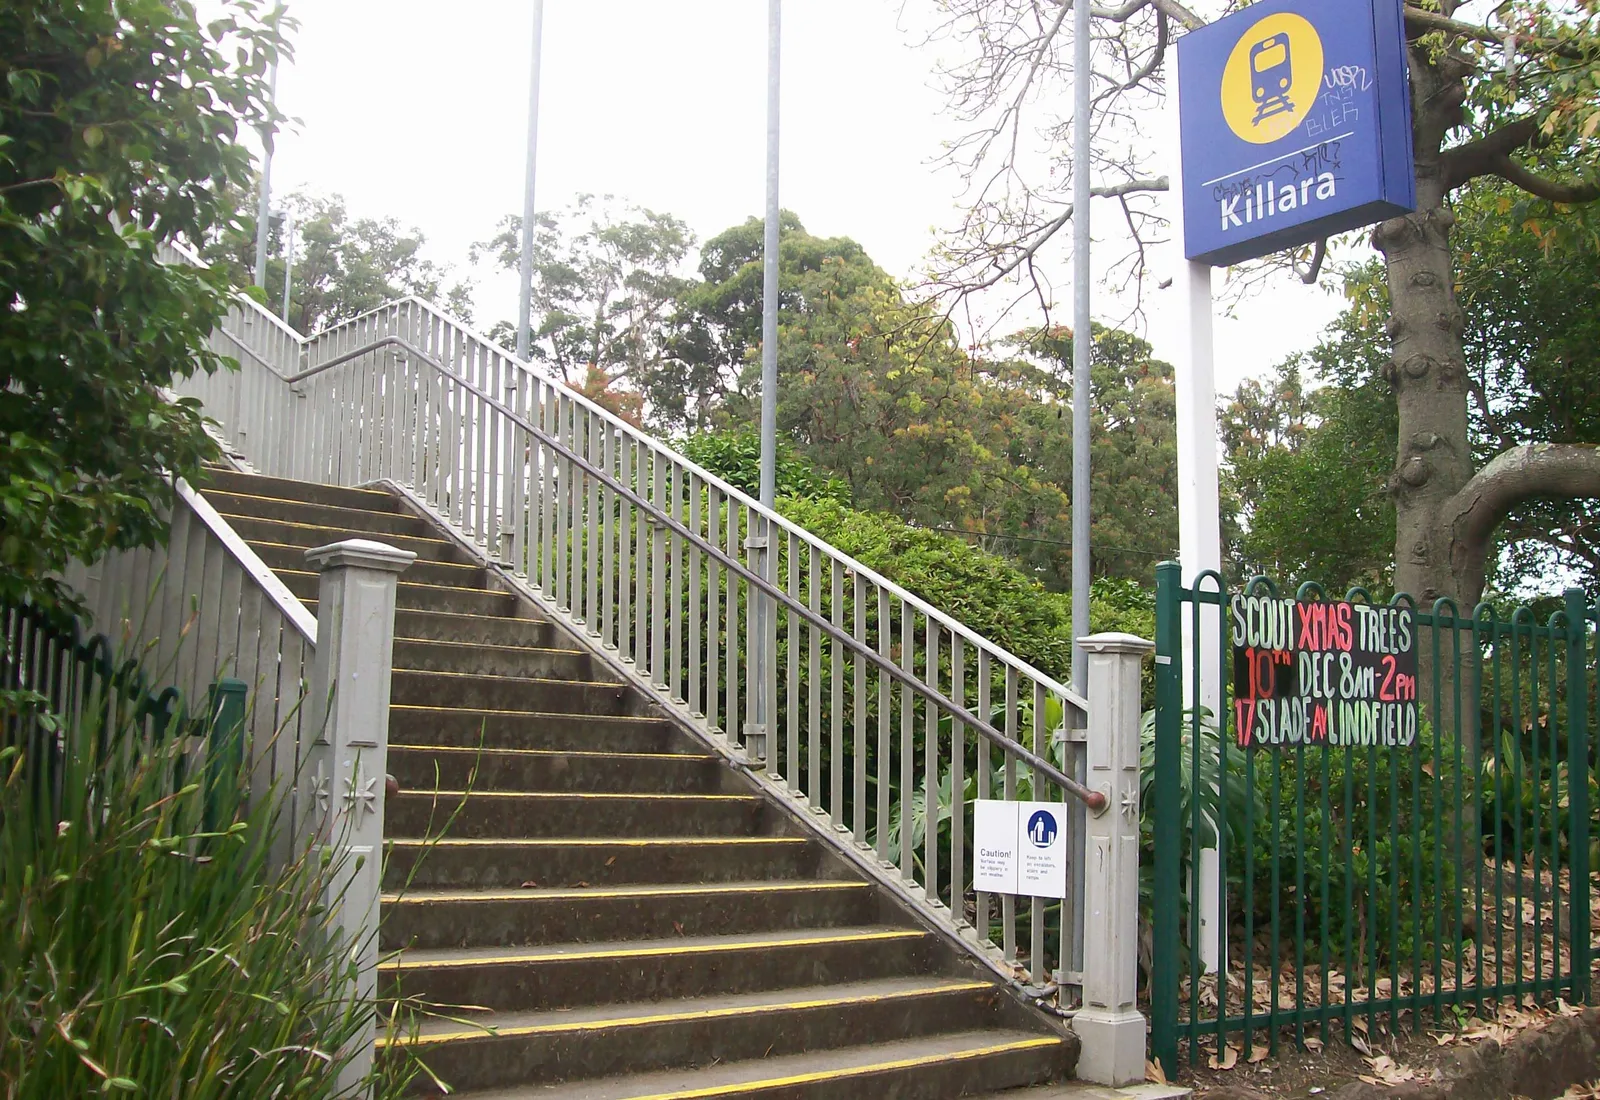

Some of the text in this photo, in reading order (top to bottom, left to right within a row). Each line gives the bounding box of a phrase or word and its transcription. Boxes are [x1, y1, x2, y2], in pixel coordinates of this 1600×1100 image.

[1221, 172, 1336, 231] Killara
[1231, 594, 1412, 654] SCOUT XMAS TREES
[1298, 651, 1335, 699] DEC
[1234, 699, 1256, 747] 17
[1256, 697, 1311, 744] SLADE
[1327, 699, 1416, 746] LINDFIELD
[980, 848, 1012, 858] Caution!
